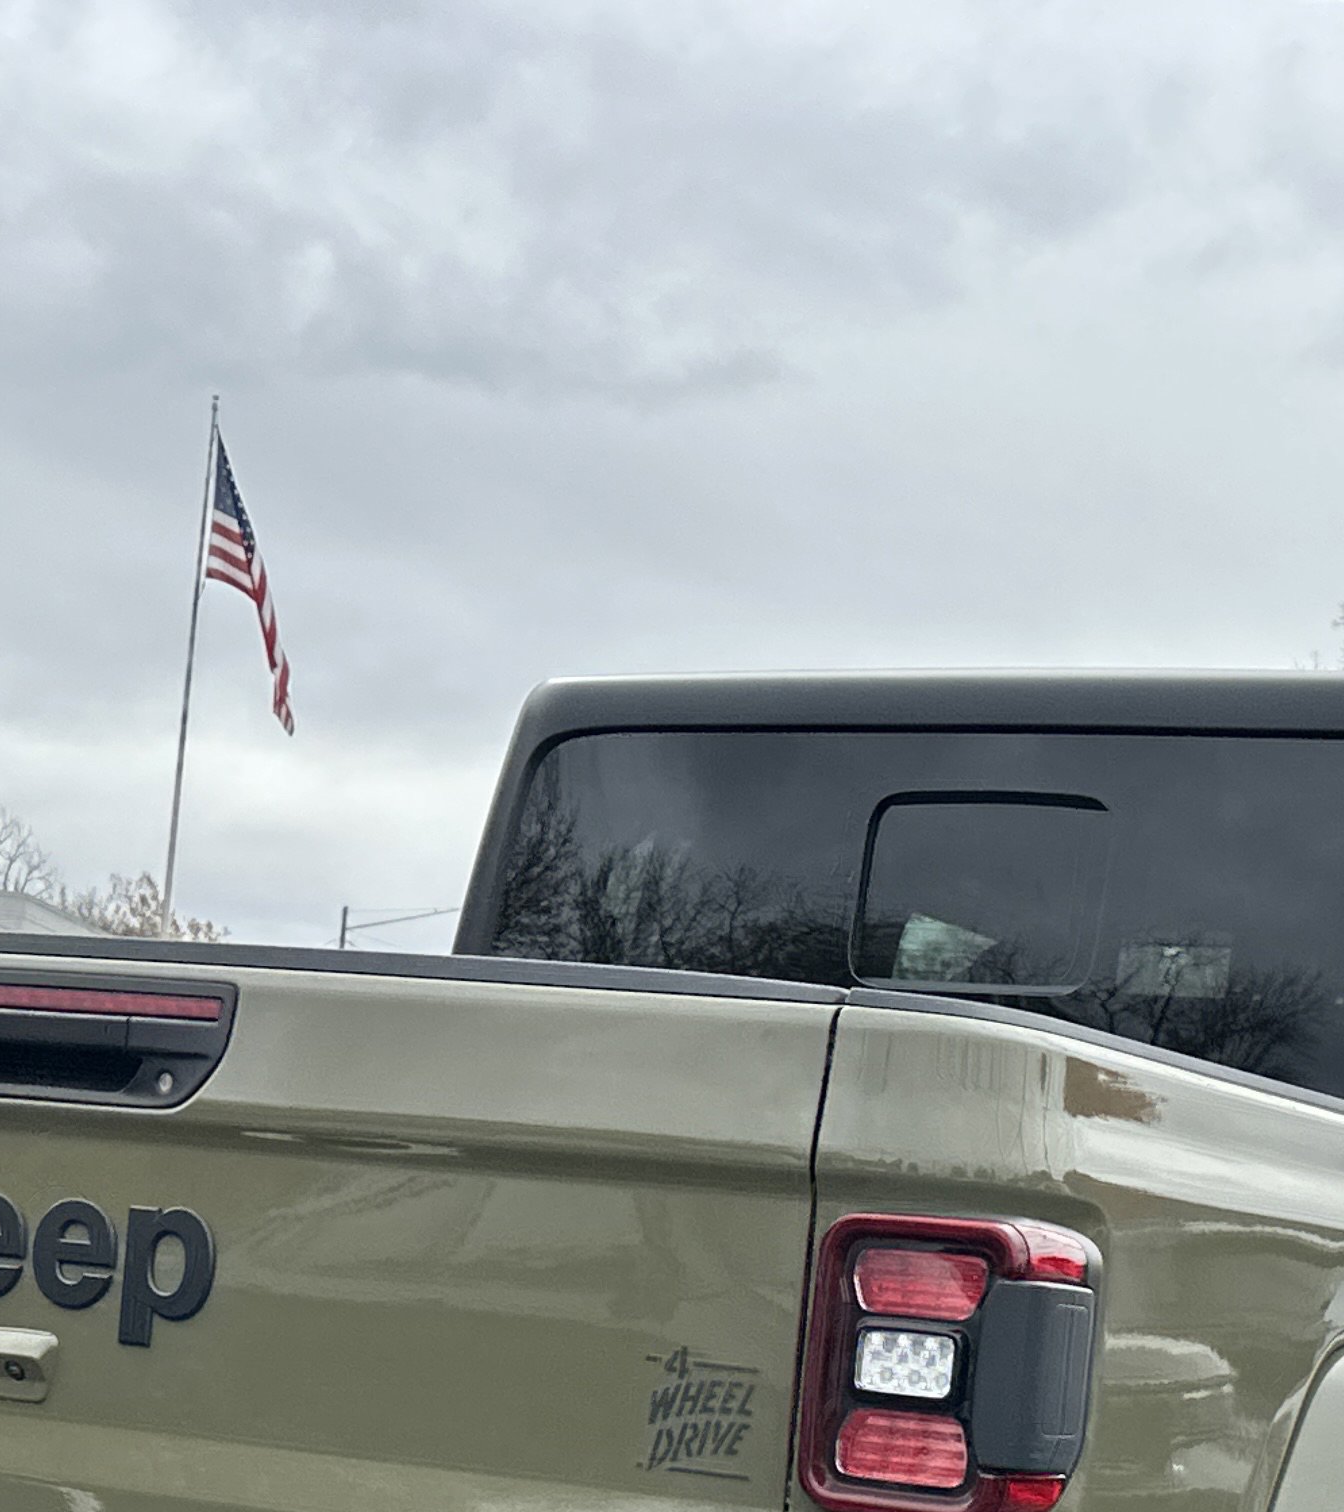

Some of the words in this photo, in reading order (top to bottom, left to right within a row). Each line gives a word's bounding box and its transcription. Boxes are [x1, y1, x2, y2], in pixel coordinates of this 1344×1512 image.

[664, 1345, 690, 1380] 4
[648, 1380, 755, 1425] WHEEL
[646, 1420, 751, 1472] DRIVE
